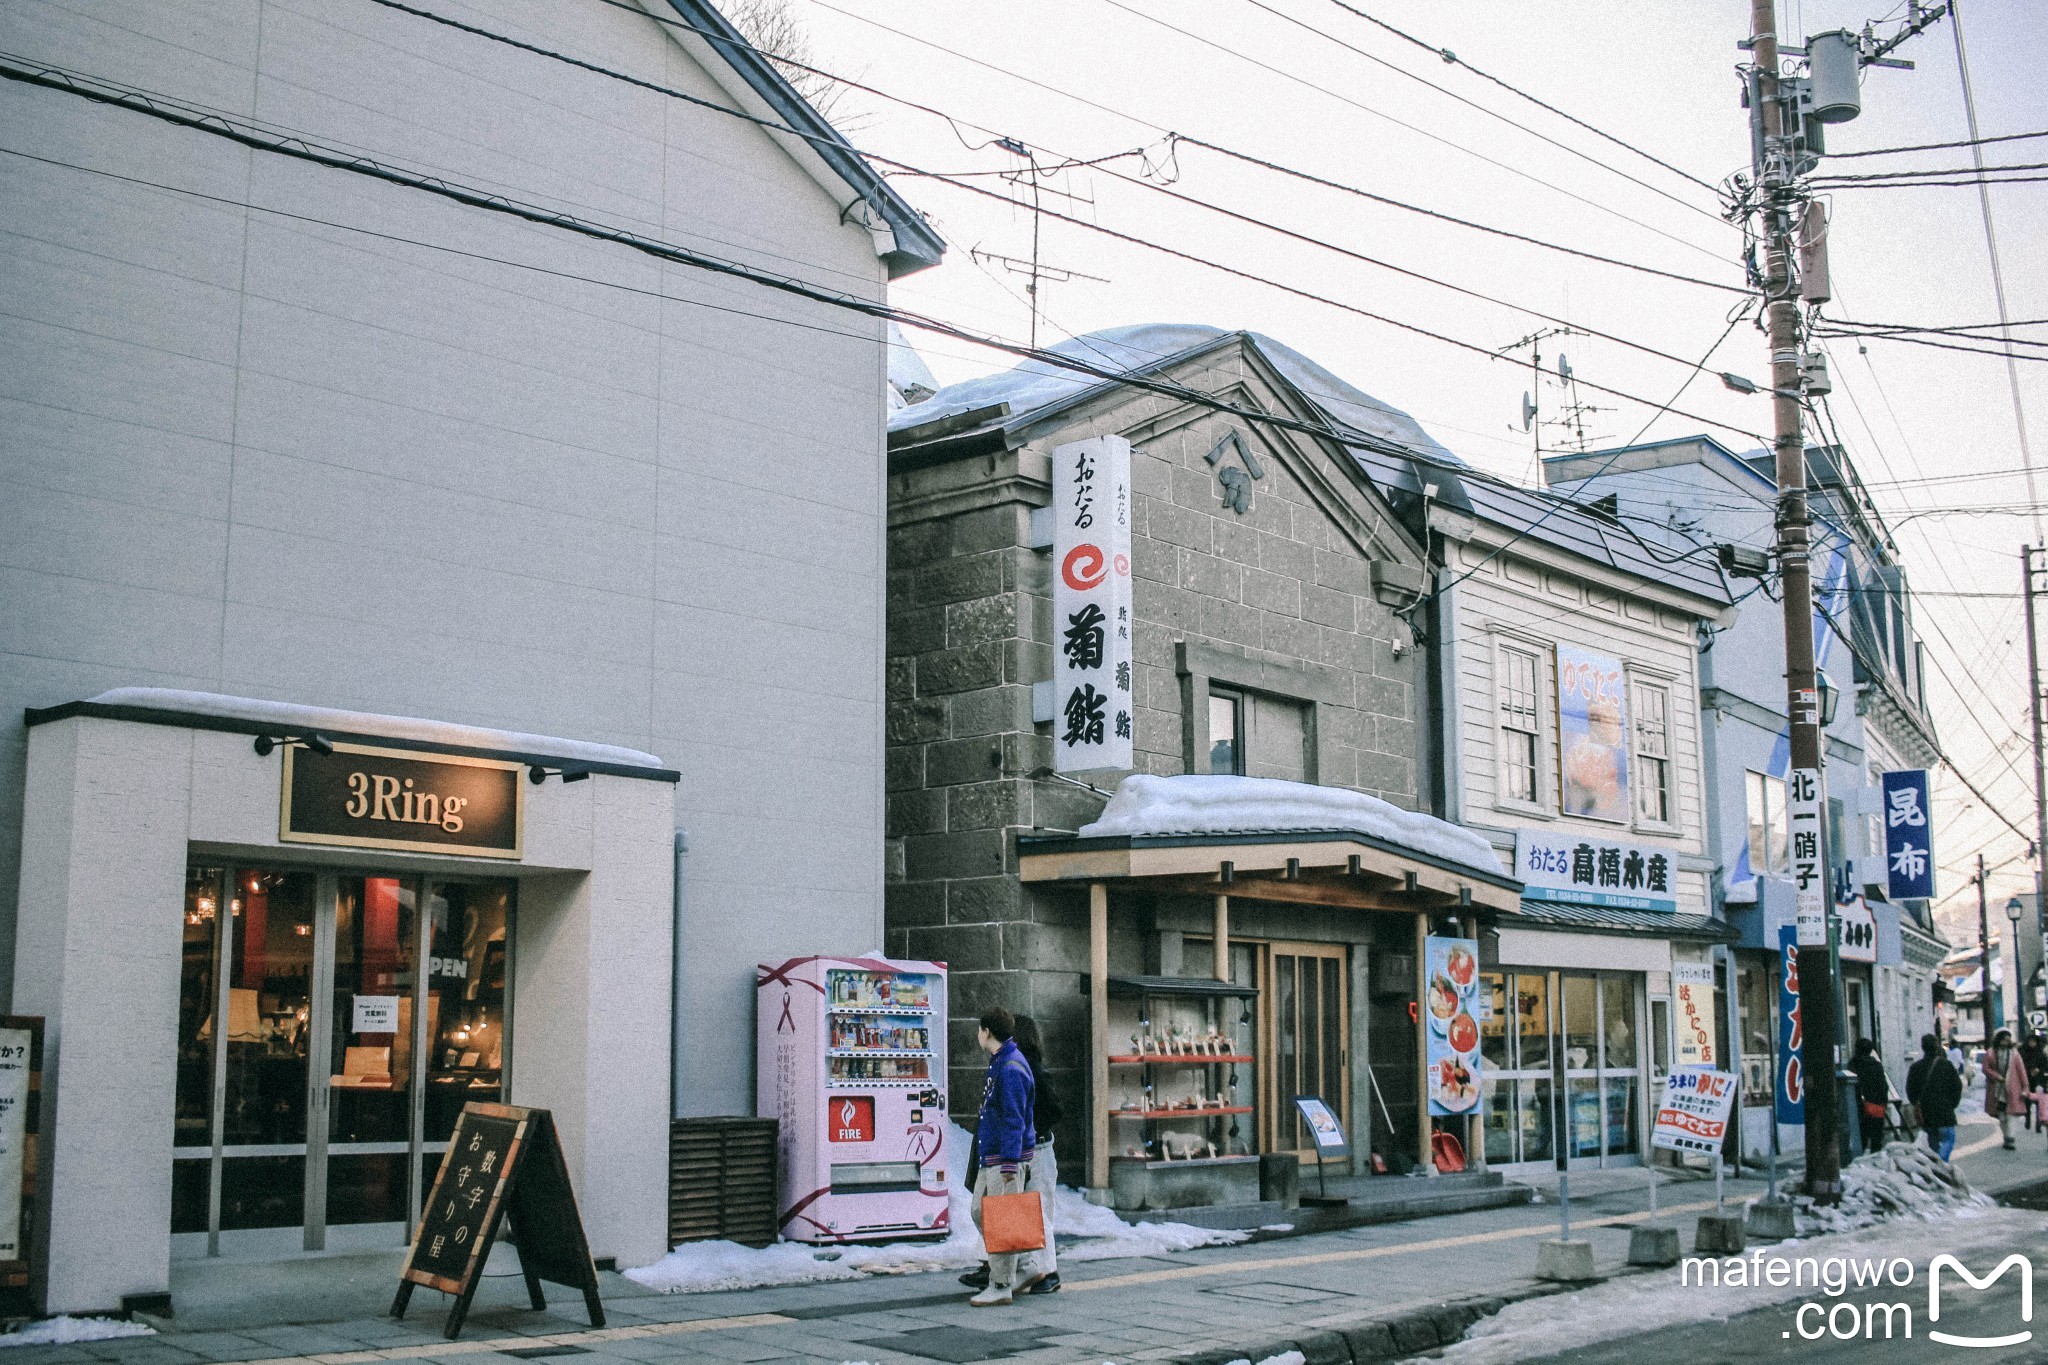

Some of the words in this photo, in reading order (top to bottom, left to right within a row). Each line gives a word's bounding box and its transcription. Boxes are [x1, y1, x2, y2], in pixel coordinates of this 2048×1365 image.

[1073, 452, 1096, 530] おたる
[1061, 602, 1109, 748] 菊鮨
[1114, 661, 1132, 741] 菊鮨
[345, 772, 468, 833] 3Ring
[1791, 772, 1819, 891] 北一硝子
[1888, 786, 1929, 882] 昆布
[1528, 843, 1568, 874] おたる
[428, 956, 468, 979] PEN
[1678, 984, 1712, 1062] 活かにの店
[838, 1128, 862, 1140] FIRE
[428, 1131, 483, 1258] お守り屋
[454, 1149, 497, 1244] 数字の
